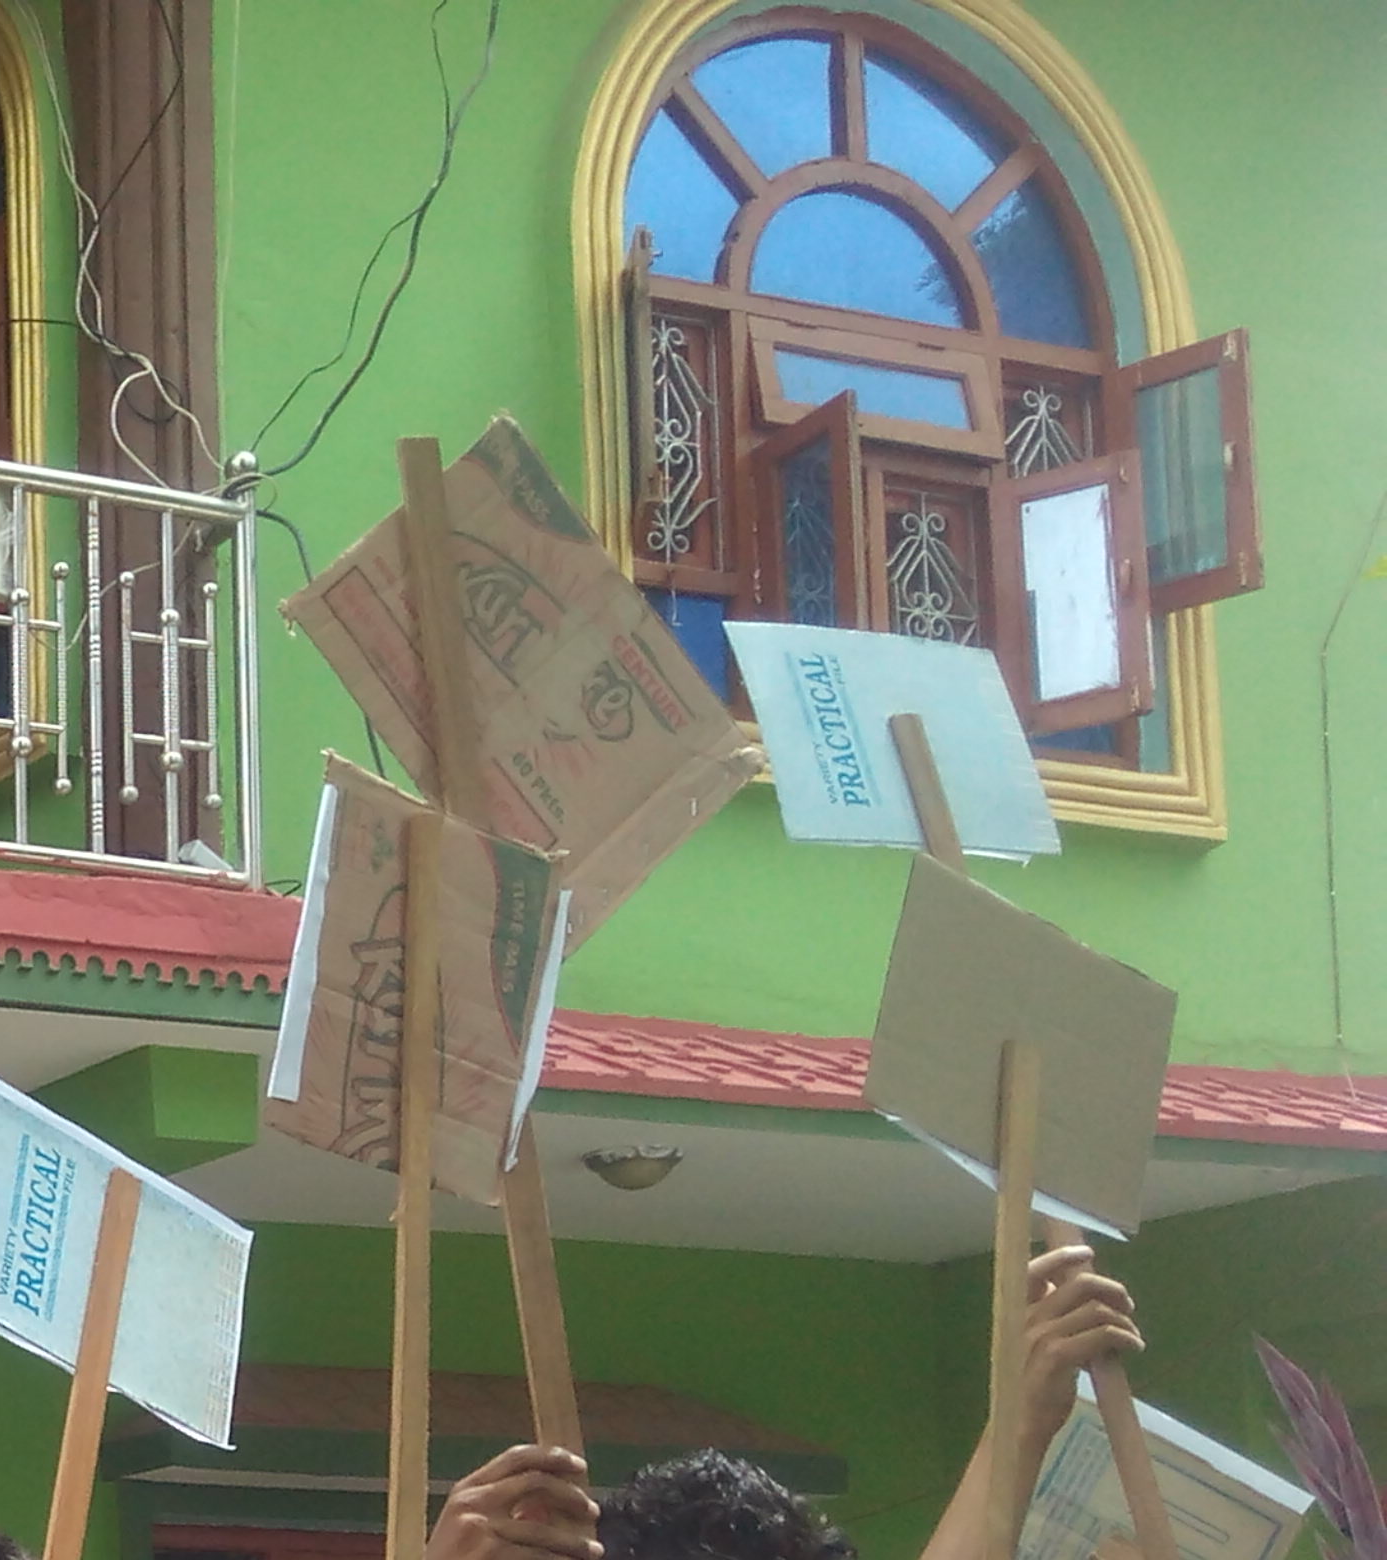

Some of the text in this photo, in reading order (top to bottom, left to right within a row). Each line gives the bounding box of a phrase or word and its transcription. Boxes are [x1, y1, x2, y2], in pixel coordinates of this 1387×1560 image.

[609, 633, 690, 733] CENTURY
[797, 652, 871, 806] PRACTICAL
[528, 775, 573, 825] Pkts.
[61, 1157, 76, 1194] FILE
[11, 1146, 60, 1316] PRACTICAL
